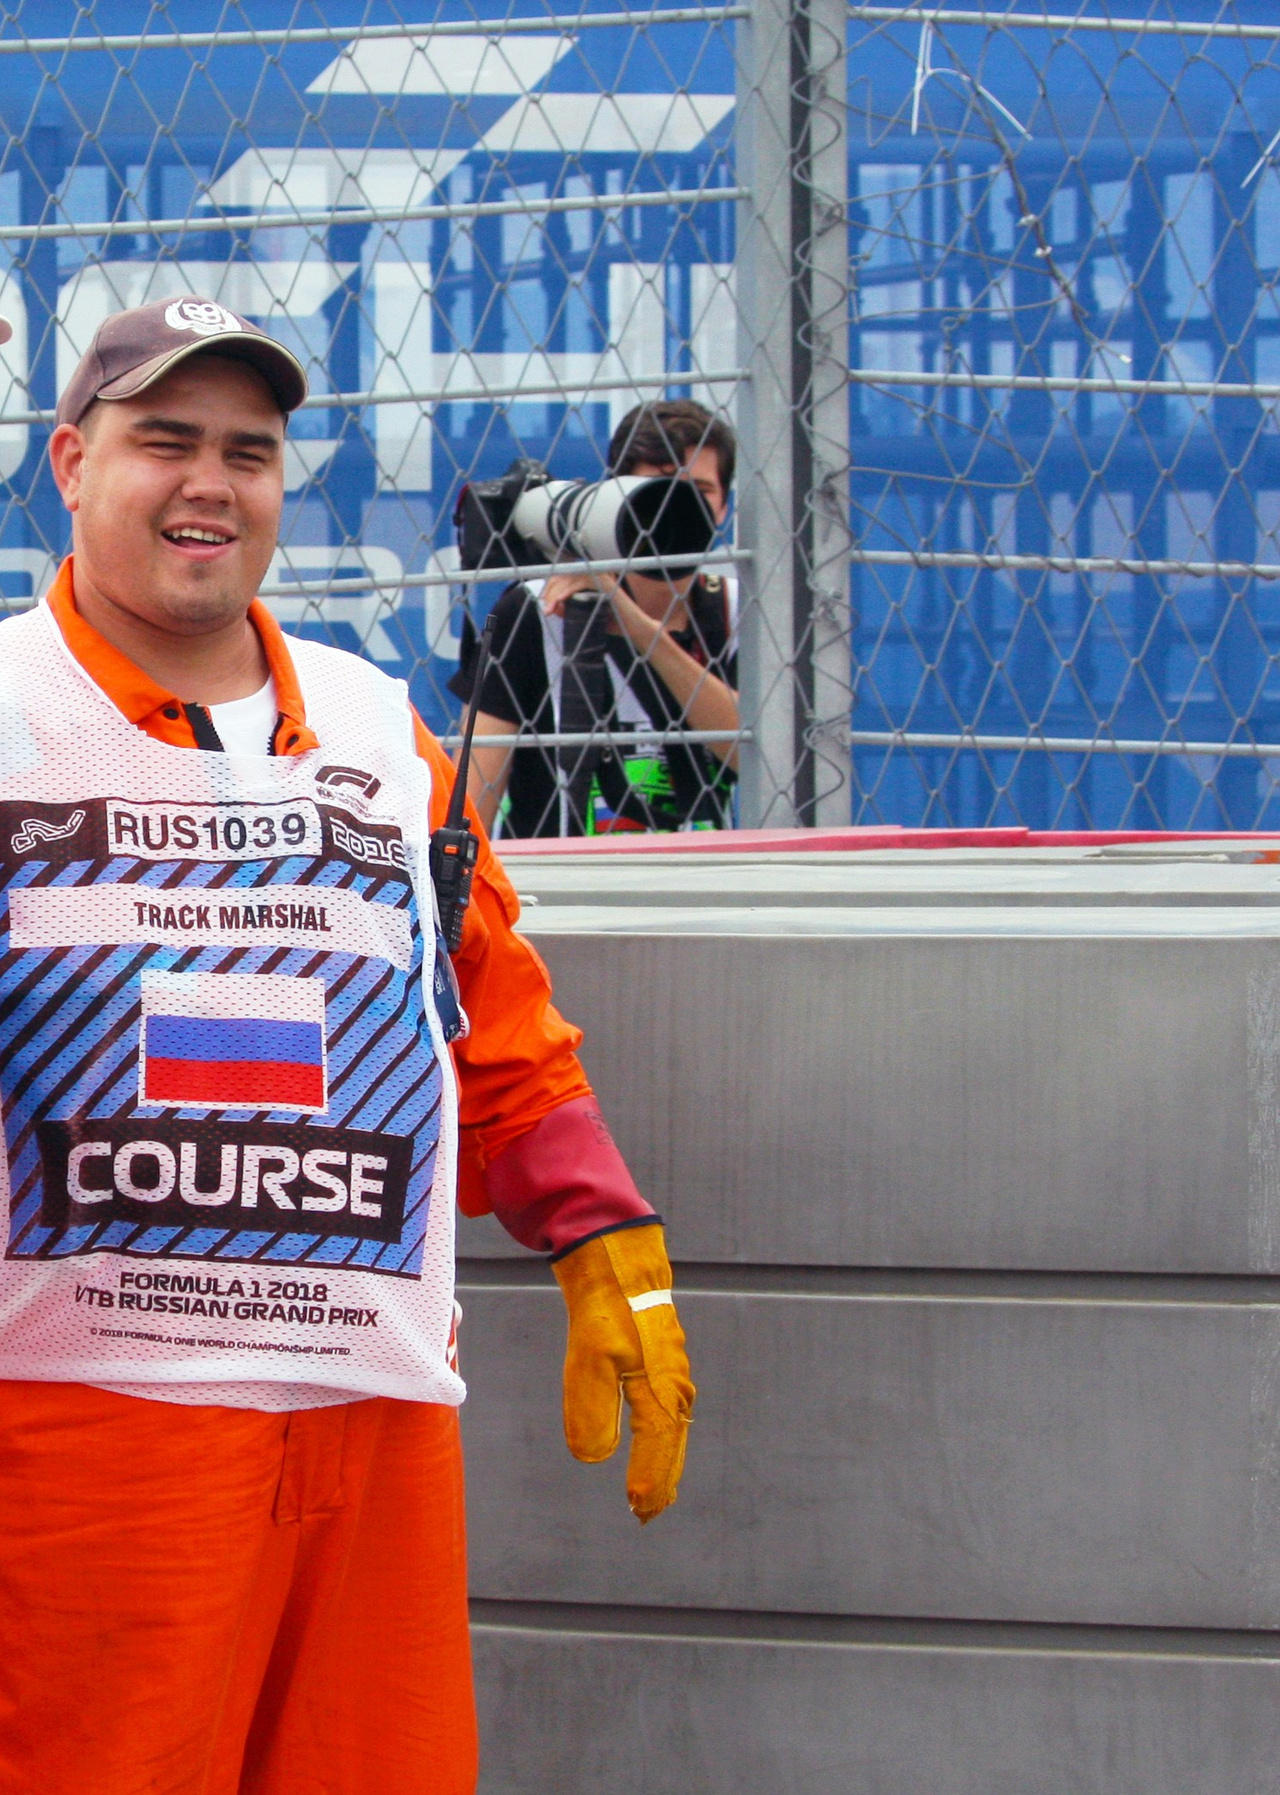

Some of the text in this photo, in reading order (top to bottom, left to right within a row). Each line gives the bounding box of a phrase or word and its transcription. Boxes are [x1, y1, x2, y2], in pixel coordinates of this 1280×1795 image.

[113, 810, 307, 851] RUS1039
[135, 901, 332, 932] TRACK MARSHAL
[66, 1140, 388, 1219] COURSE
[120, 1271, 328, 1301] FORMULA 1 2018
[75, 1285, 379, 1328] VTB RUSSIAN GRAND PRIX
[124, 1330, 172, 1344] FORMULA
[174, 1337, 196, 1346] ONE
[197, 1338, 235, 1349] WORLD
[237, 1341, 314, 1355] CHAMPIONSHIP
